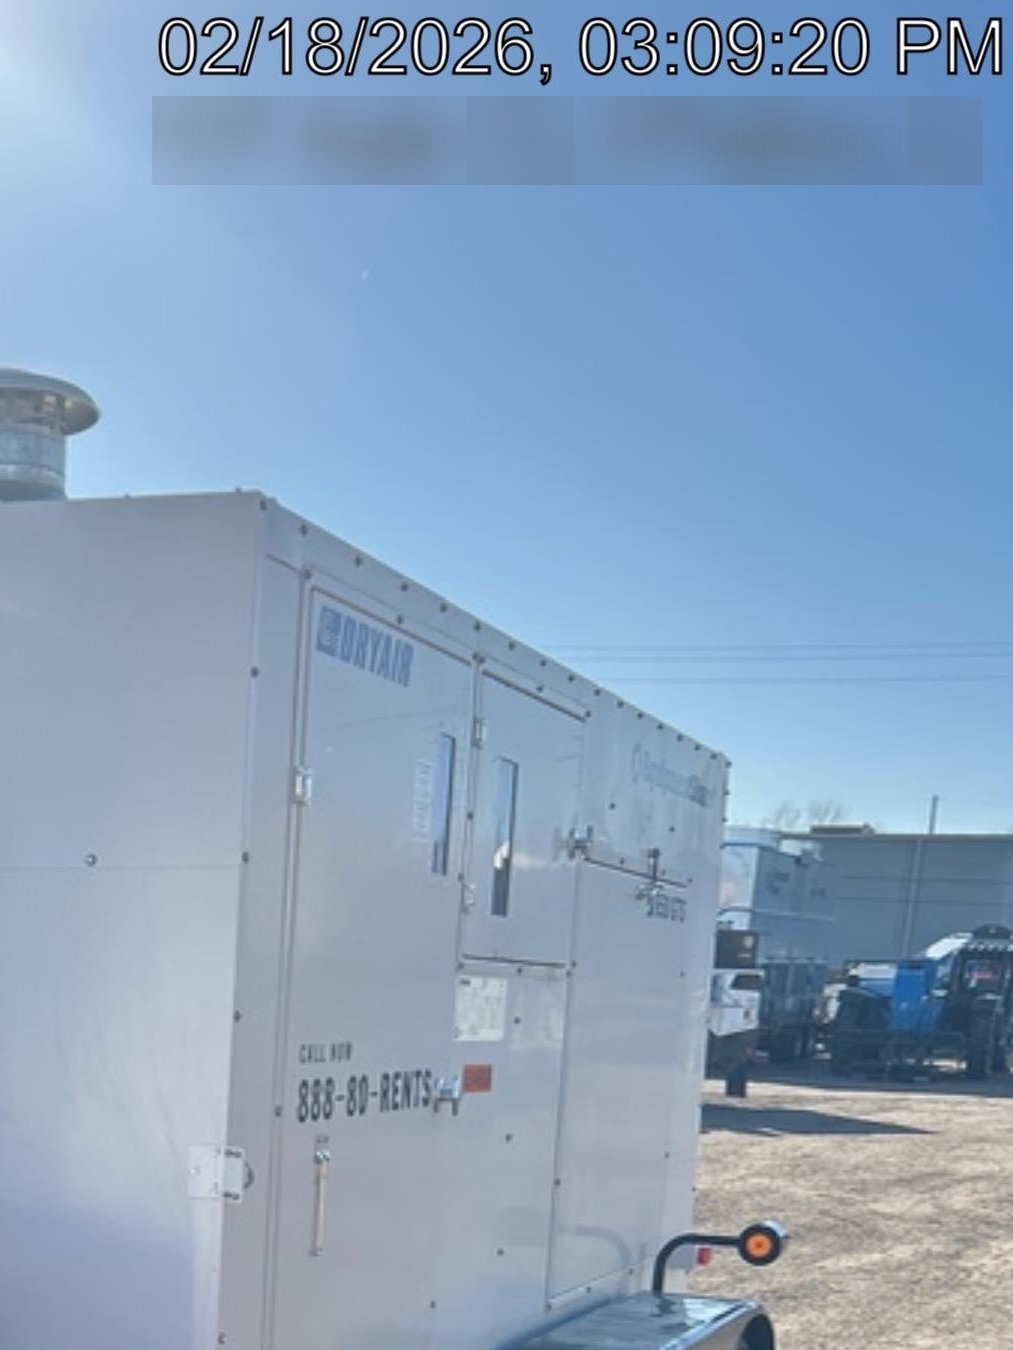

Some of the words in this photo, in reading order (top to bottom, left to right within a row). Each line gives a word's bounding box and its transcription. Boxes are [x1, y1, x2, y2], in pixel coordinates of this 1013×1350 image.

[340, 615, 415, 688] DRYAIR
[298, 1043, 327, 1064] CALL
[328, 1041, 354, 1062] NOW
[297, 1067, 432, 1124] 888-80-RENTS
